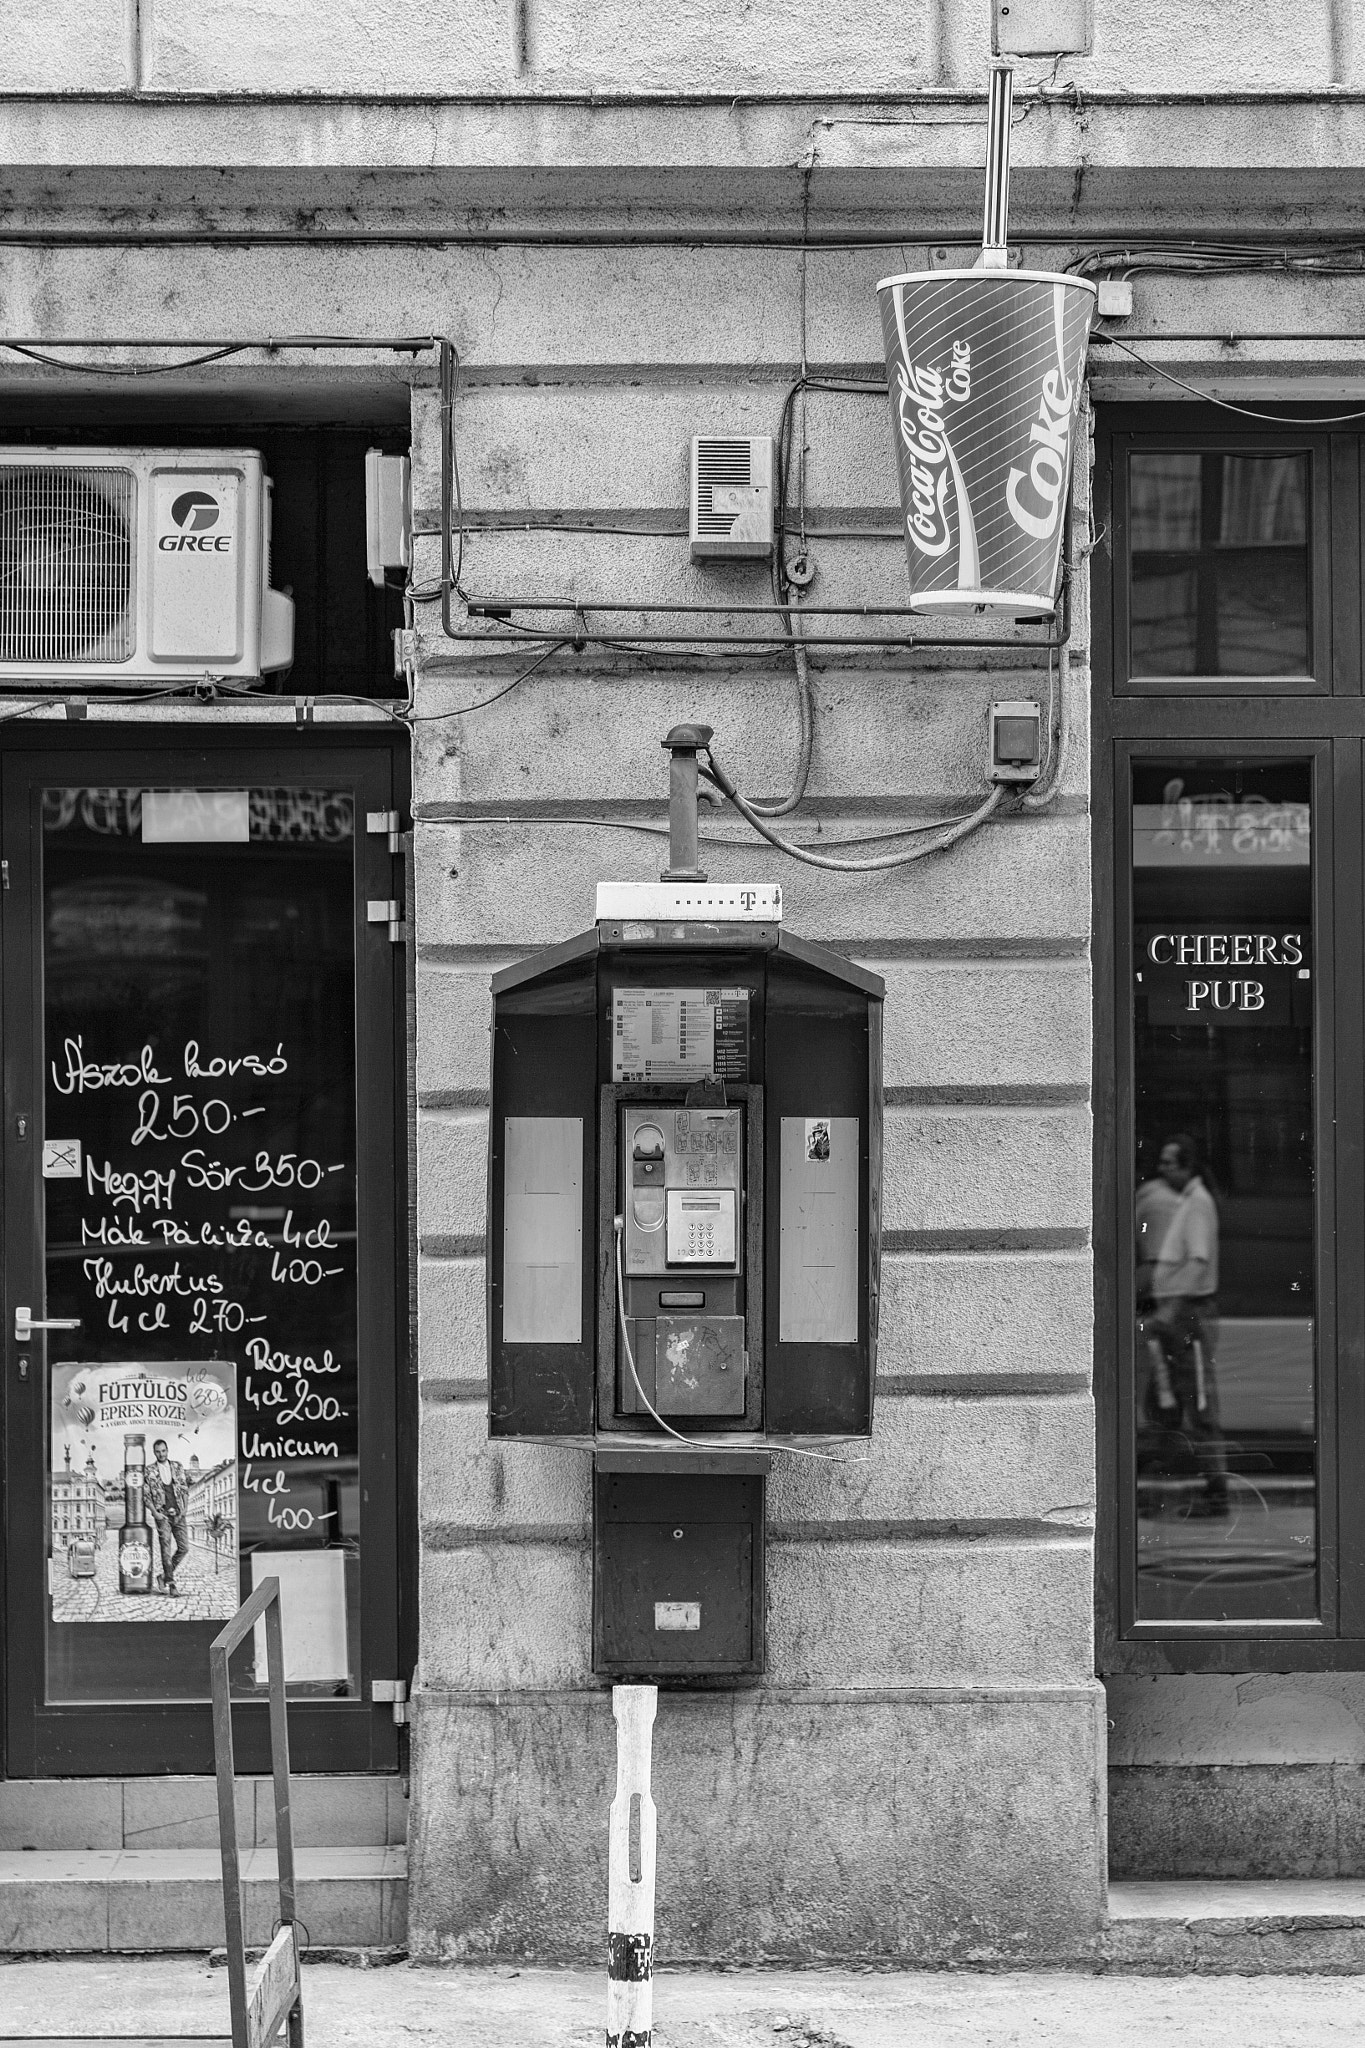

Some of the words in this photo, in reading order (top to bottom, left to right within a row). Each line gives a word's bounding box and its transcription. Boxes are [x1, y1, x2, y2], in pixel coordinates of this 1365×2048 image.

[945, 340, 972, 402] Coke
[897, 361, 951, 557] Coca-Cola
[1006, 368, 1073, 540] Coke
[158, 535, 232, 552] GREE
[1148, 933, 1303, 965] CHEERS
[1185, 979, 1265, 1011] PUB
[83, 1256, 225, 1298] Hubertus
[245, 1337, 341, 1379] Royal
[99, 1380, 188, 1402] FÜTYÜLŐS
[101, 1404, 144, 1422] EPRES
[148, 1403, 187, 1421] ROZÉ
[242, 1431, 339, 1459] Unicum
